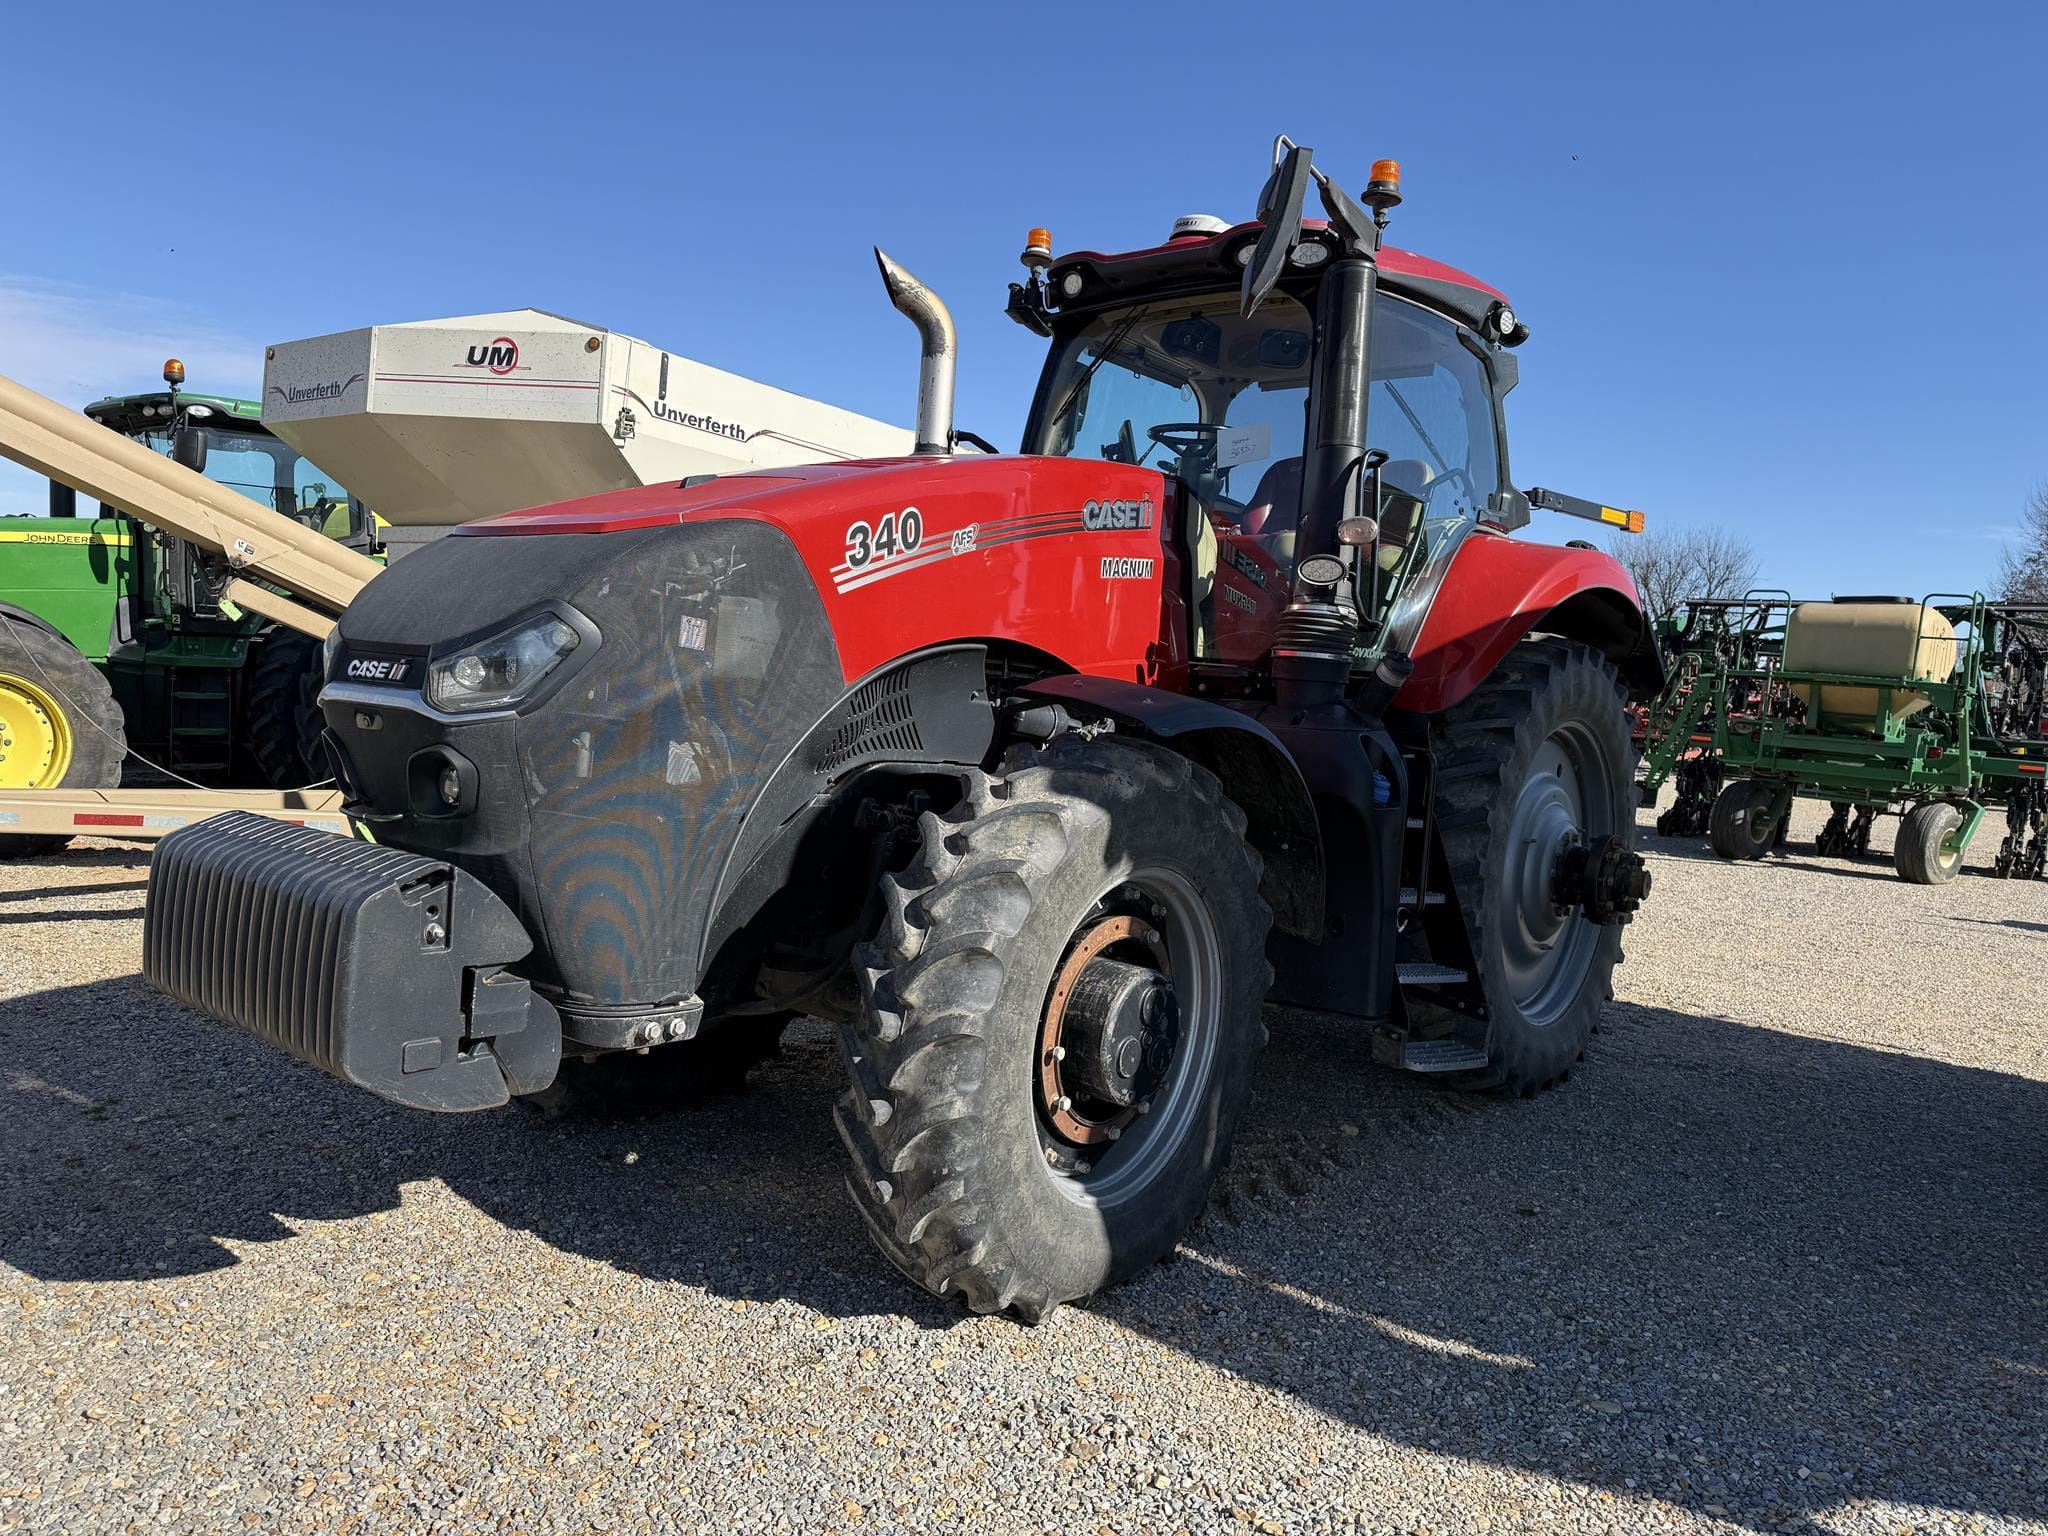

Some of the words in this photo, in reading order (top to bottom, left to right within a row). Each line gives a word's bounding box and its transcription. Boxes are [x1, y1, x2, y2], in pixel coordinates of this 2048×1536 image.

[467, 345, 514, 367] UM
[289, 381, 341, 401] Unverferth
[654, 400, 746, 441] Unverferth
[1083, 499, 1138, 530] CASE
[23, 533, 56, 544] JOHN
[57, 534, 97, 545] DEERE
[846, 507, 923, 570] 340
[953, 529, 974, 547] AFS
[1101, 557, 1154, 579] MAGNUM
[347, 660, 389, 678] CASE
